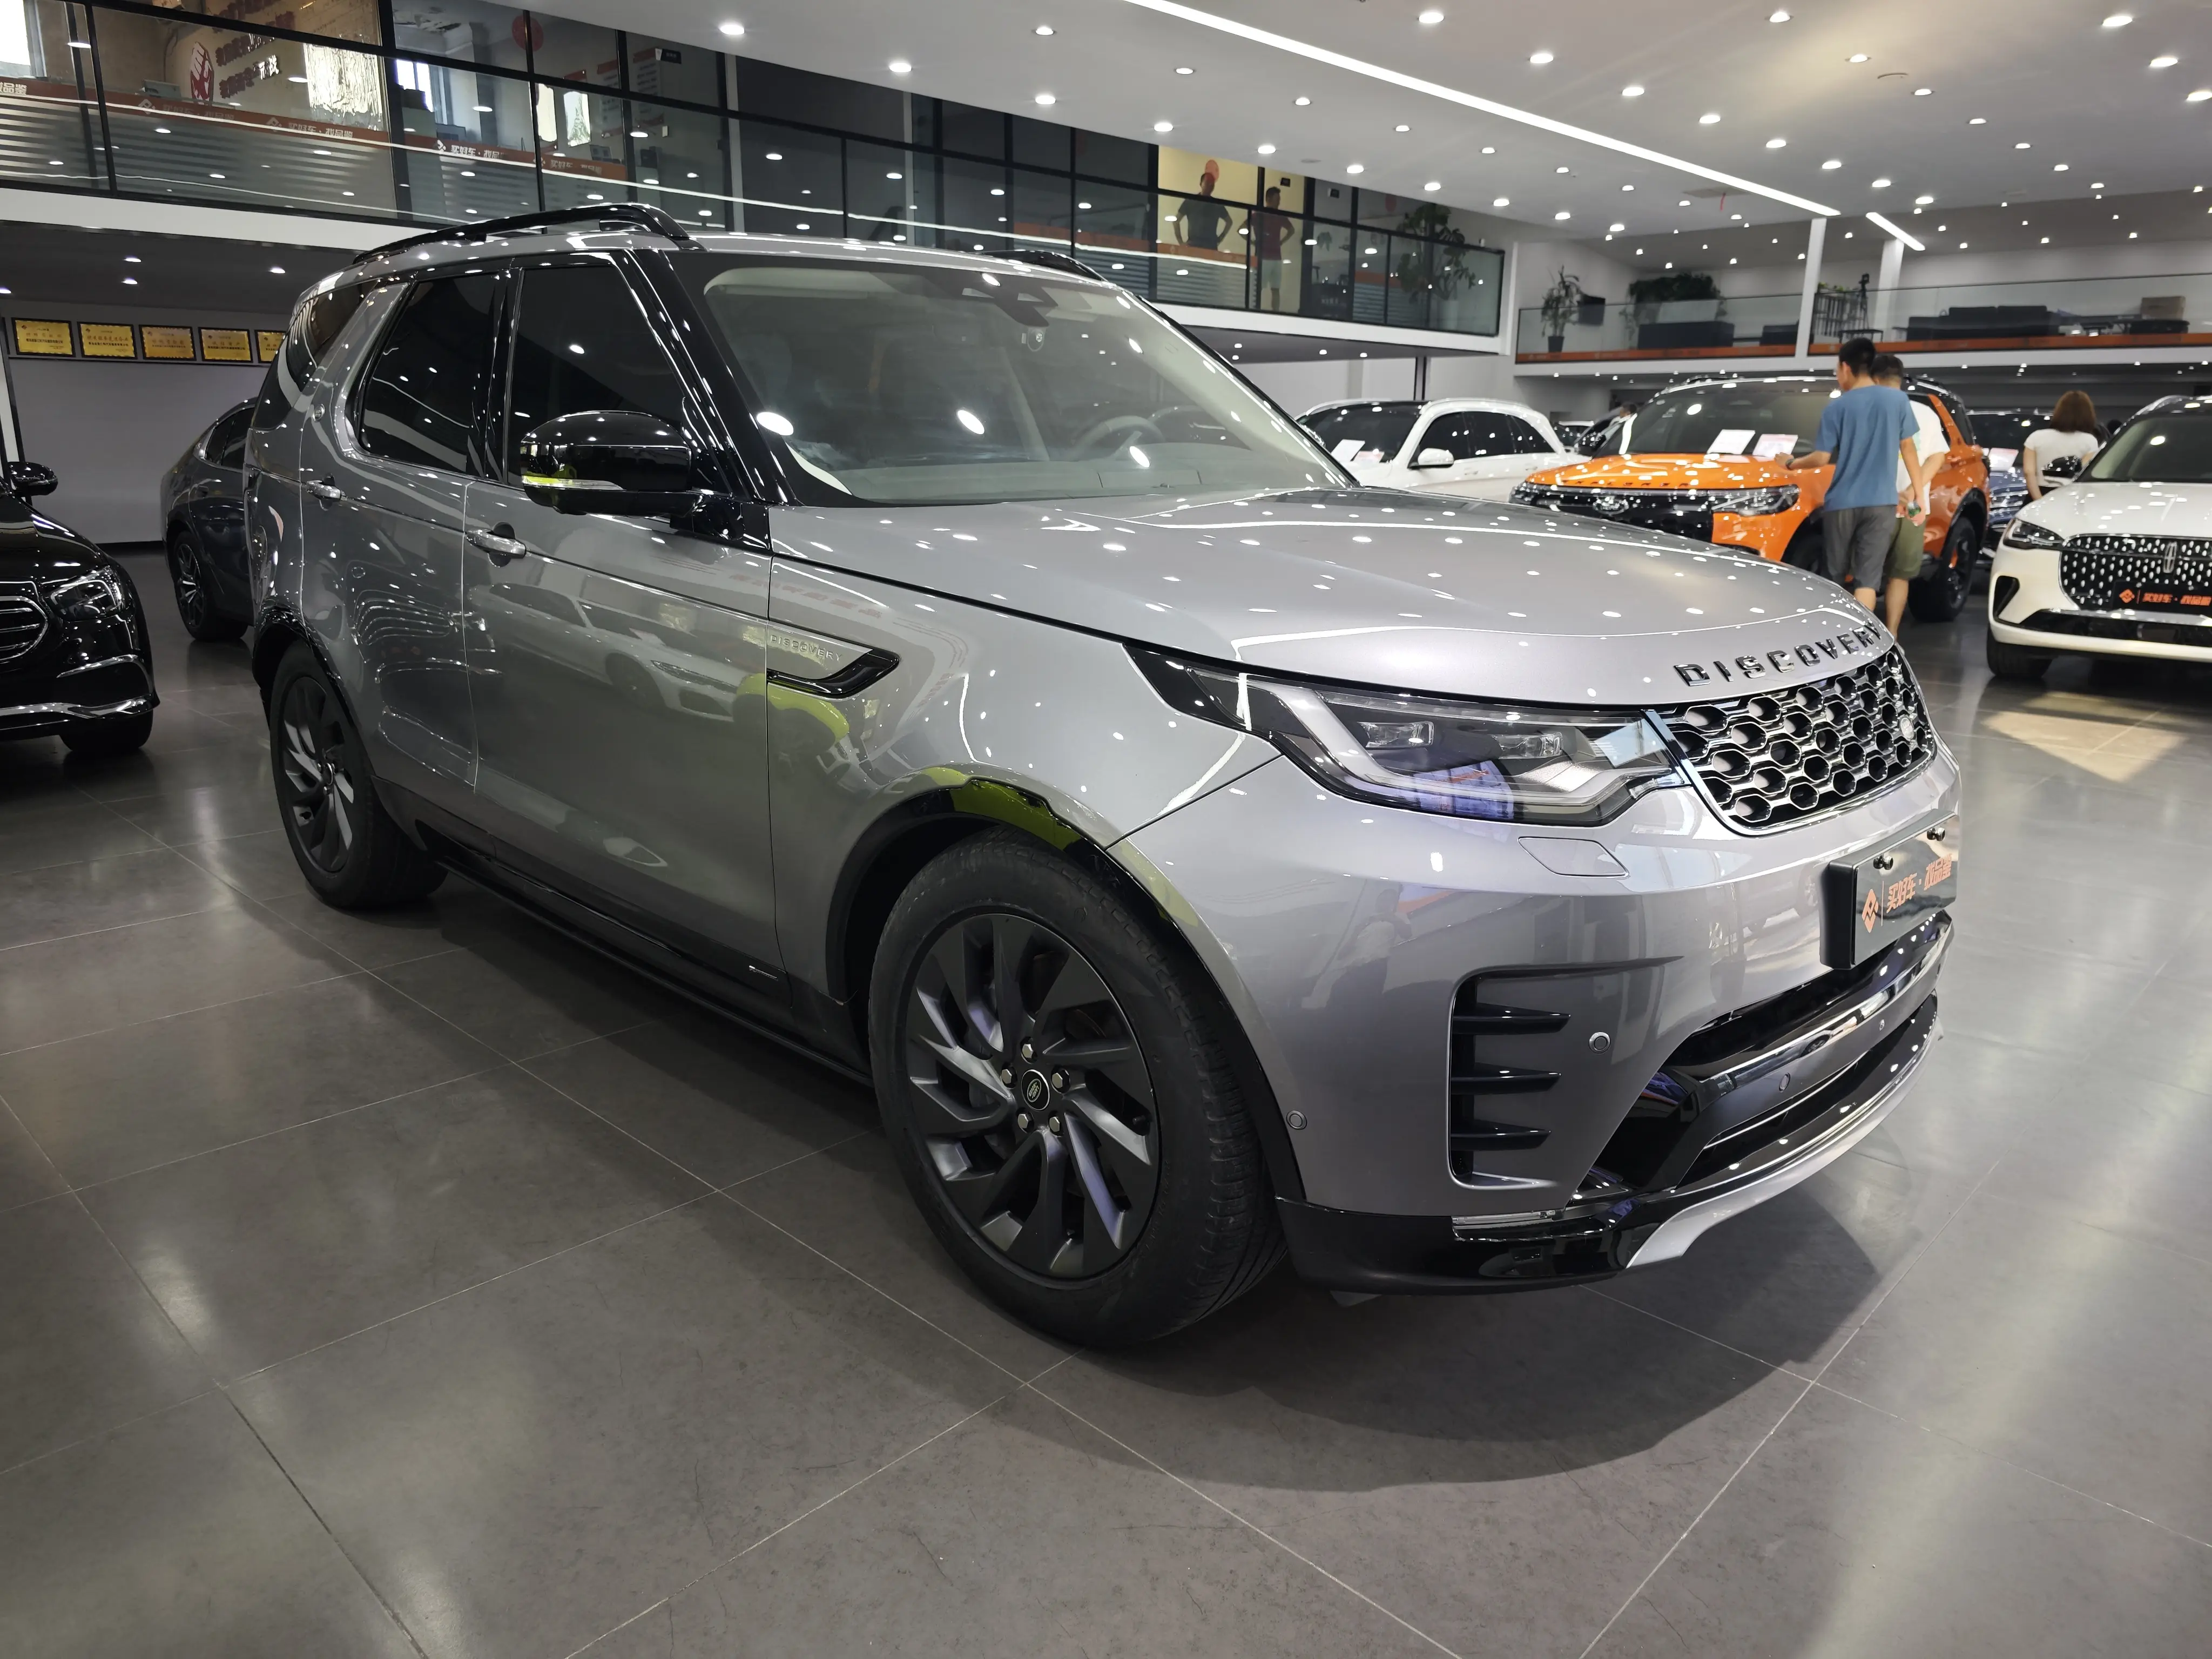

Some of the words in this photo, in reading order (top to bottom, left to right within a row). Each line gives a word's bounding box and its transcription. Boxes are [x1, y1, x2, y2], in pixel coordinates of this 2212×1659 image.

[0, 82, 27, 95] 品鉴
[771, 635, 842, 662] DISCOVERY
[1673, 622, 1881, 687] DISCOVERY
